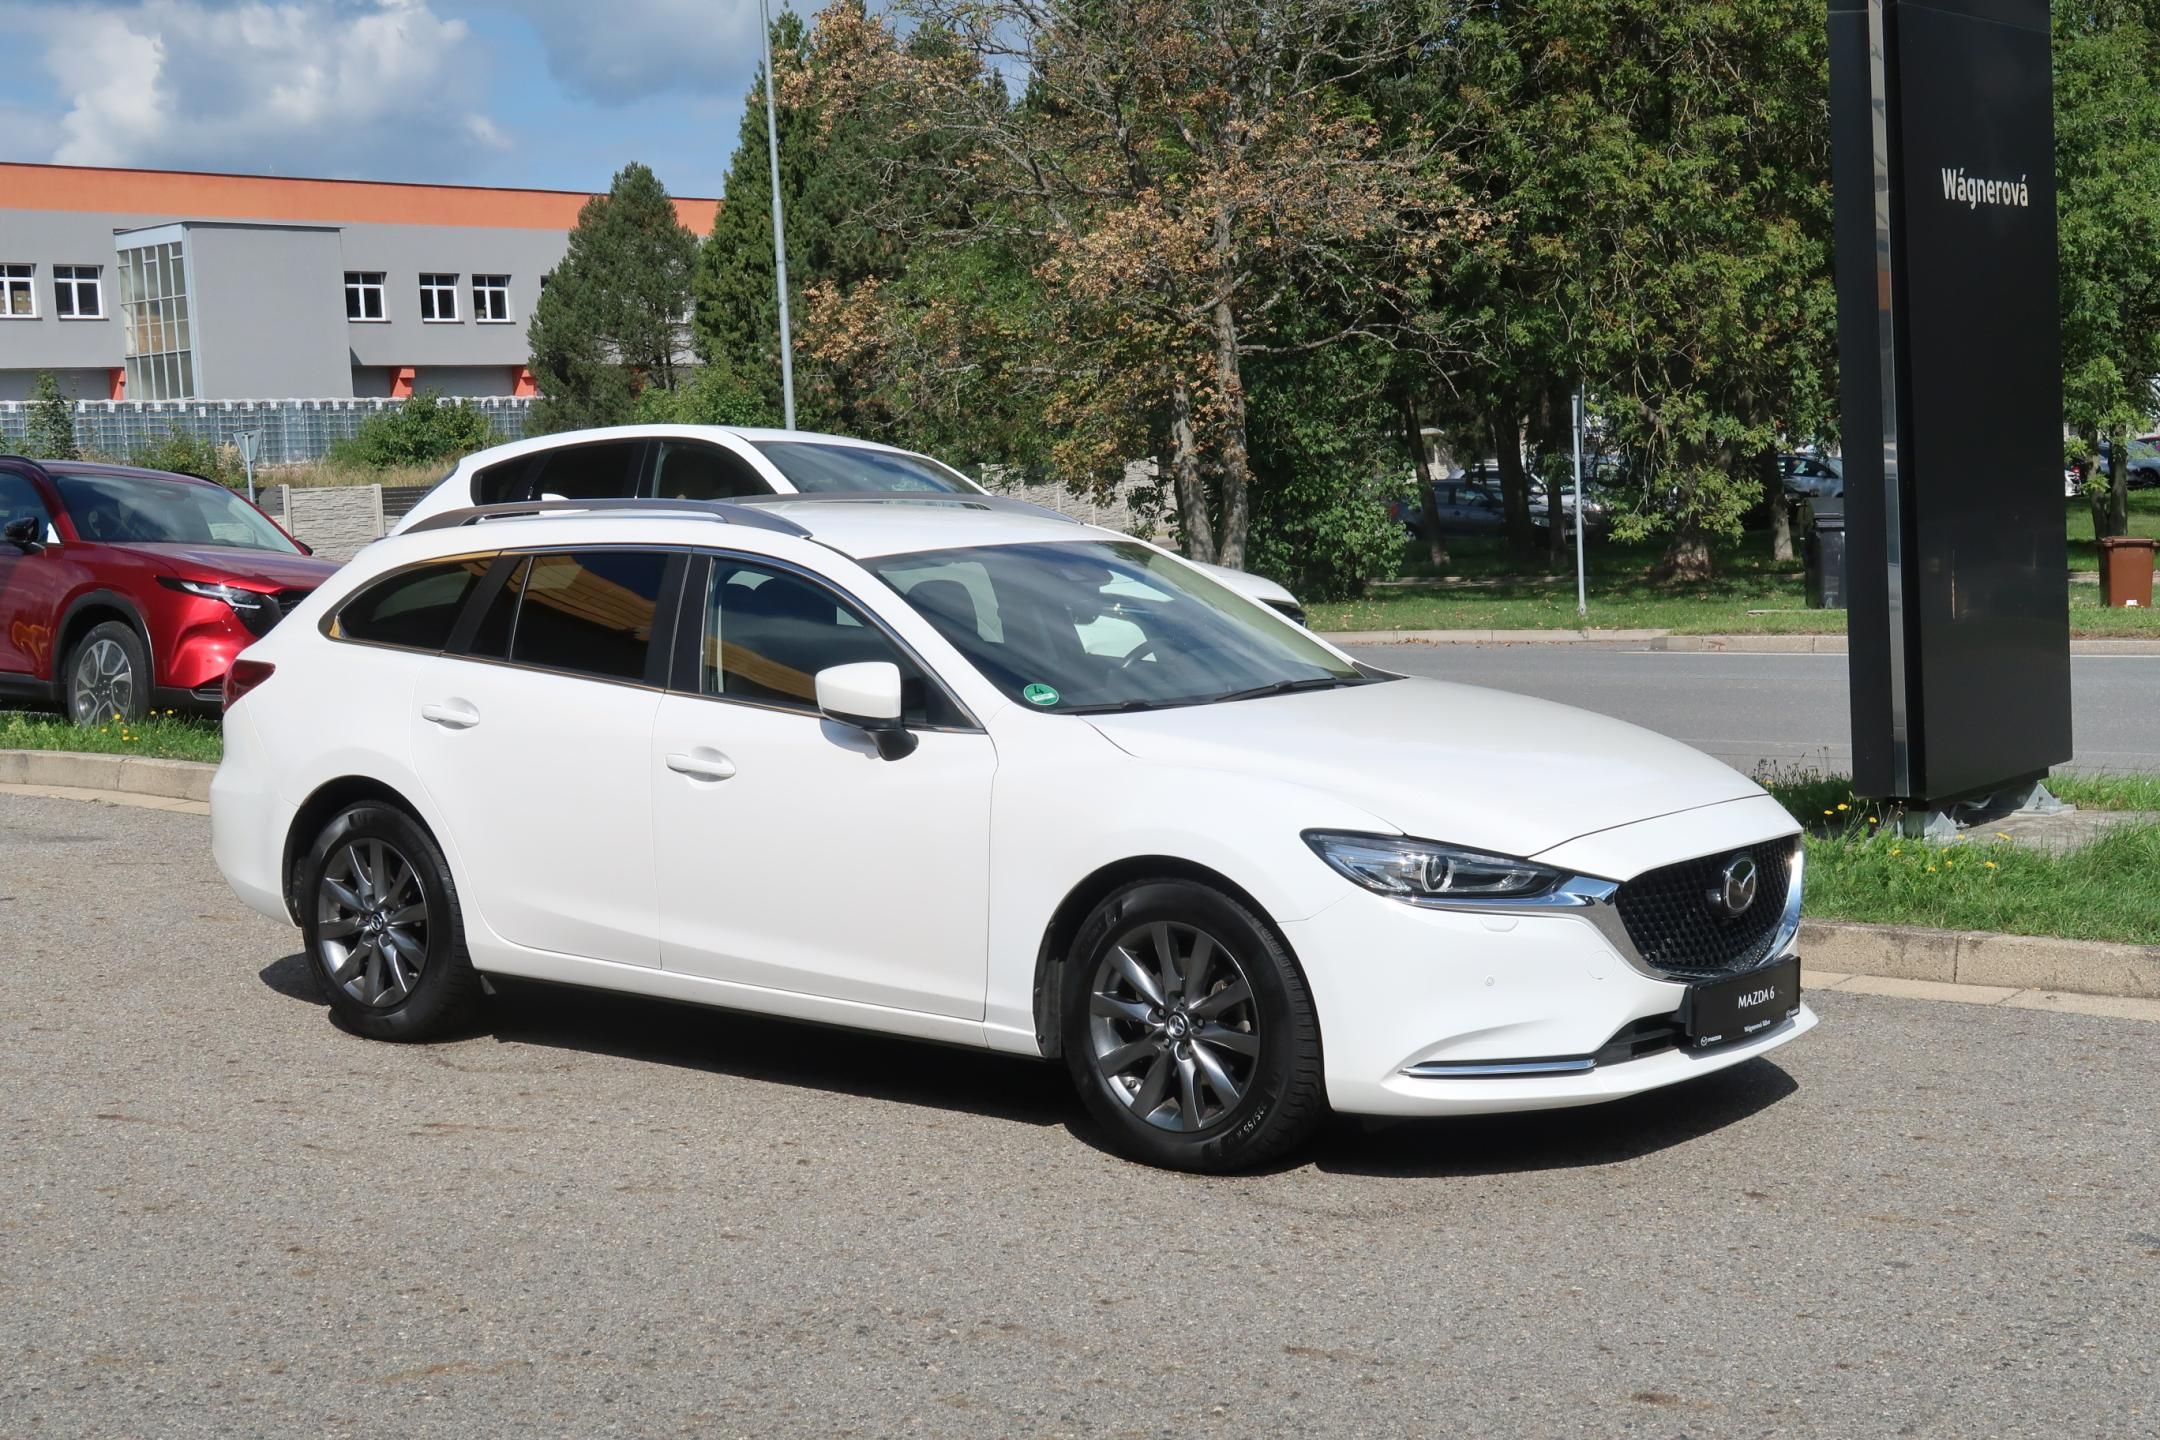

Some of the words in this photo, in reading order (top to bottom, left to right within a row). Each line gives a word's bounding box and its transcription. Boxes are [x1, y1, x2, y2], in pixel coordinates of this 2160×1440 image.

[1941, 167, 2029, 210] Wágnerová
[1738, 988, 1769, 1008] MAZDA
[1770, 985, 1775, 1000] 6
